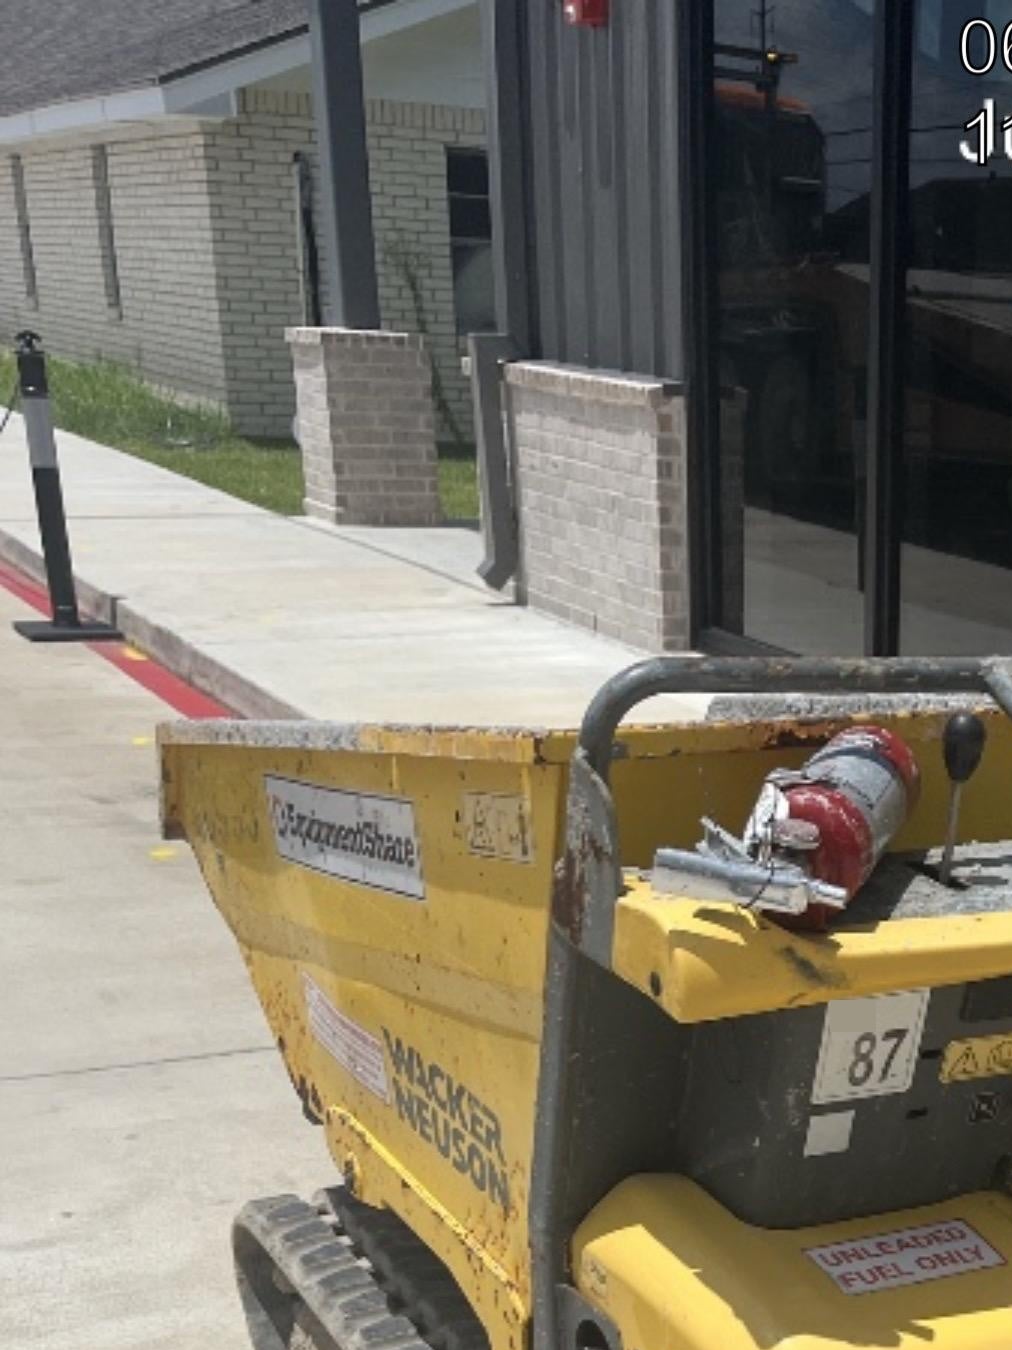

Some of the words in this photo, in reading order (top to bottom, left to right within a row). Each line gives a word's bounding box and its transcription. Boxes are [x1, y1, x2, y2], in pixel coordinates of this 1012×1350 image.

[848, 1028, 910, 1087] 87
[381, 1025, 507, 1167] WACKER
[392, 1076, 510, 1220] NEUSON
[818, 1226, 967, 1267] UNLEADED
[838, 1262, 914, 1288] FUEL
[914, 1244, 985, 1271] ONLY
